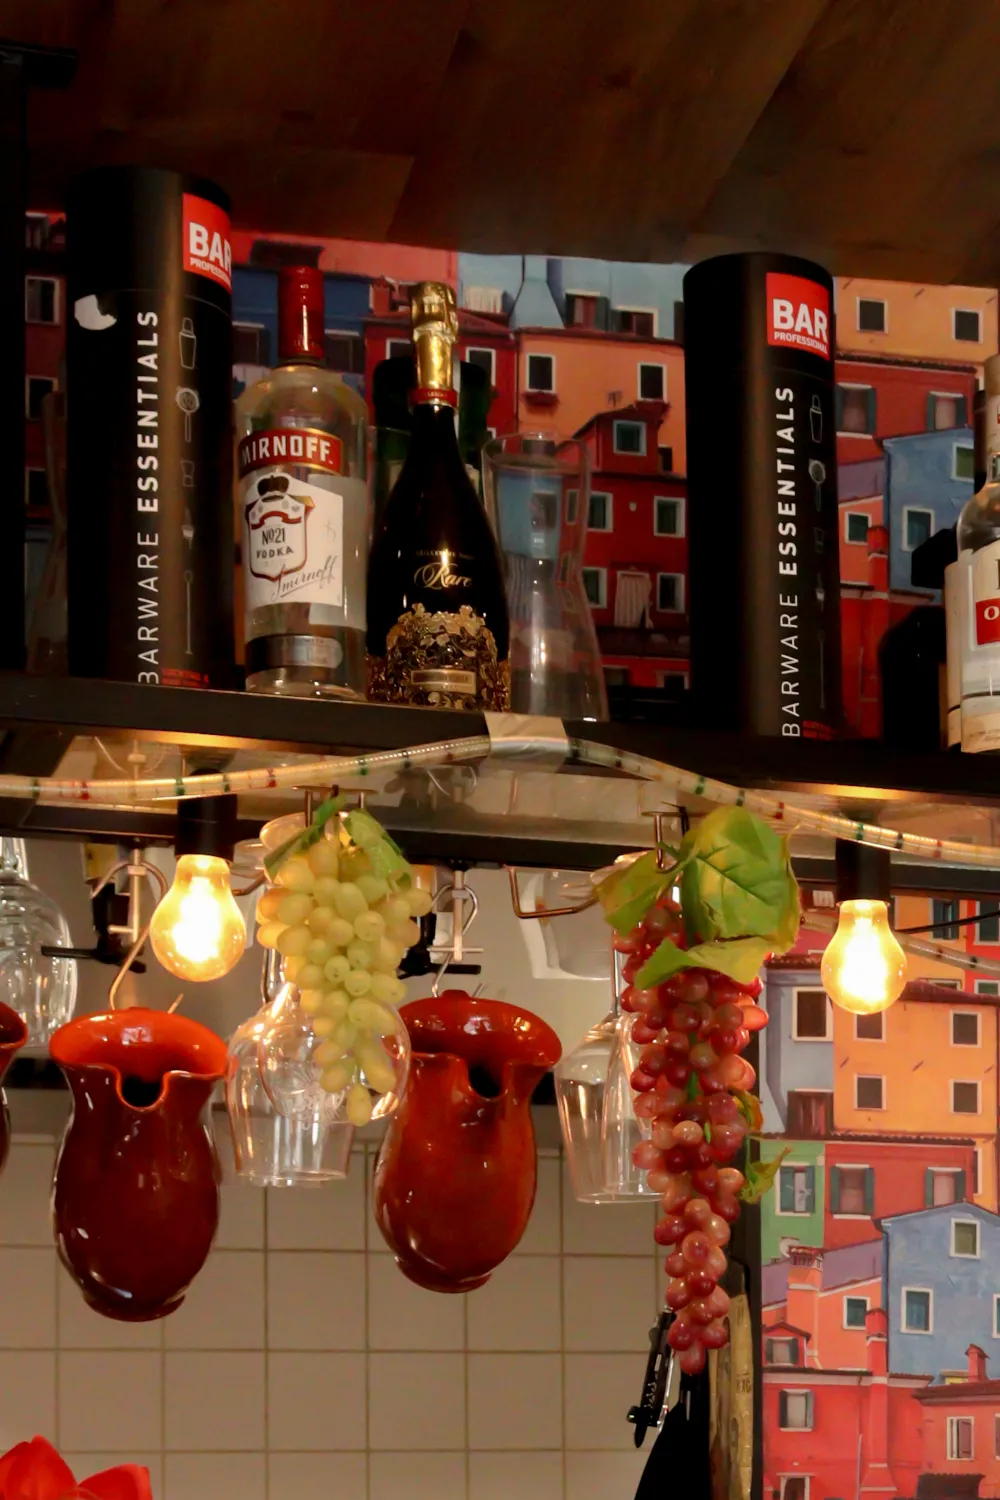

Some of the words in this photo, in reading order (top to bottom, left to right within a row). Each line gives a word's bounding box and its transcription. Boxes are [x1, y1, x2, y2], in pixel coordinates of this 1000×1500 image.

[189, 221, 232, 278] BAR
[772, 298, 828, 343] BAR
[137, 311, 159, 512] ESSENTIALS
[242, 435, 332, 465] MIRNOFF
[775, 387, 798, 576] ESSENTIALS
[256, 547, 294, 559] VODKA
[414, 561, 472, 590] Rare
[137, 532, 159, 684] BARWARE
[779, 593, 801, 737] BARWARE
